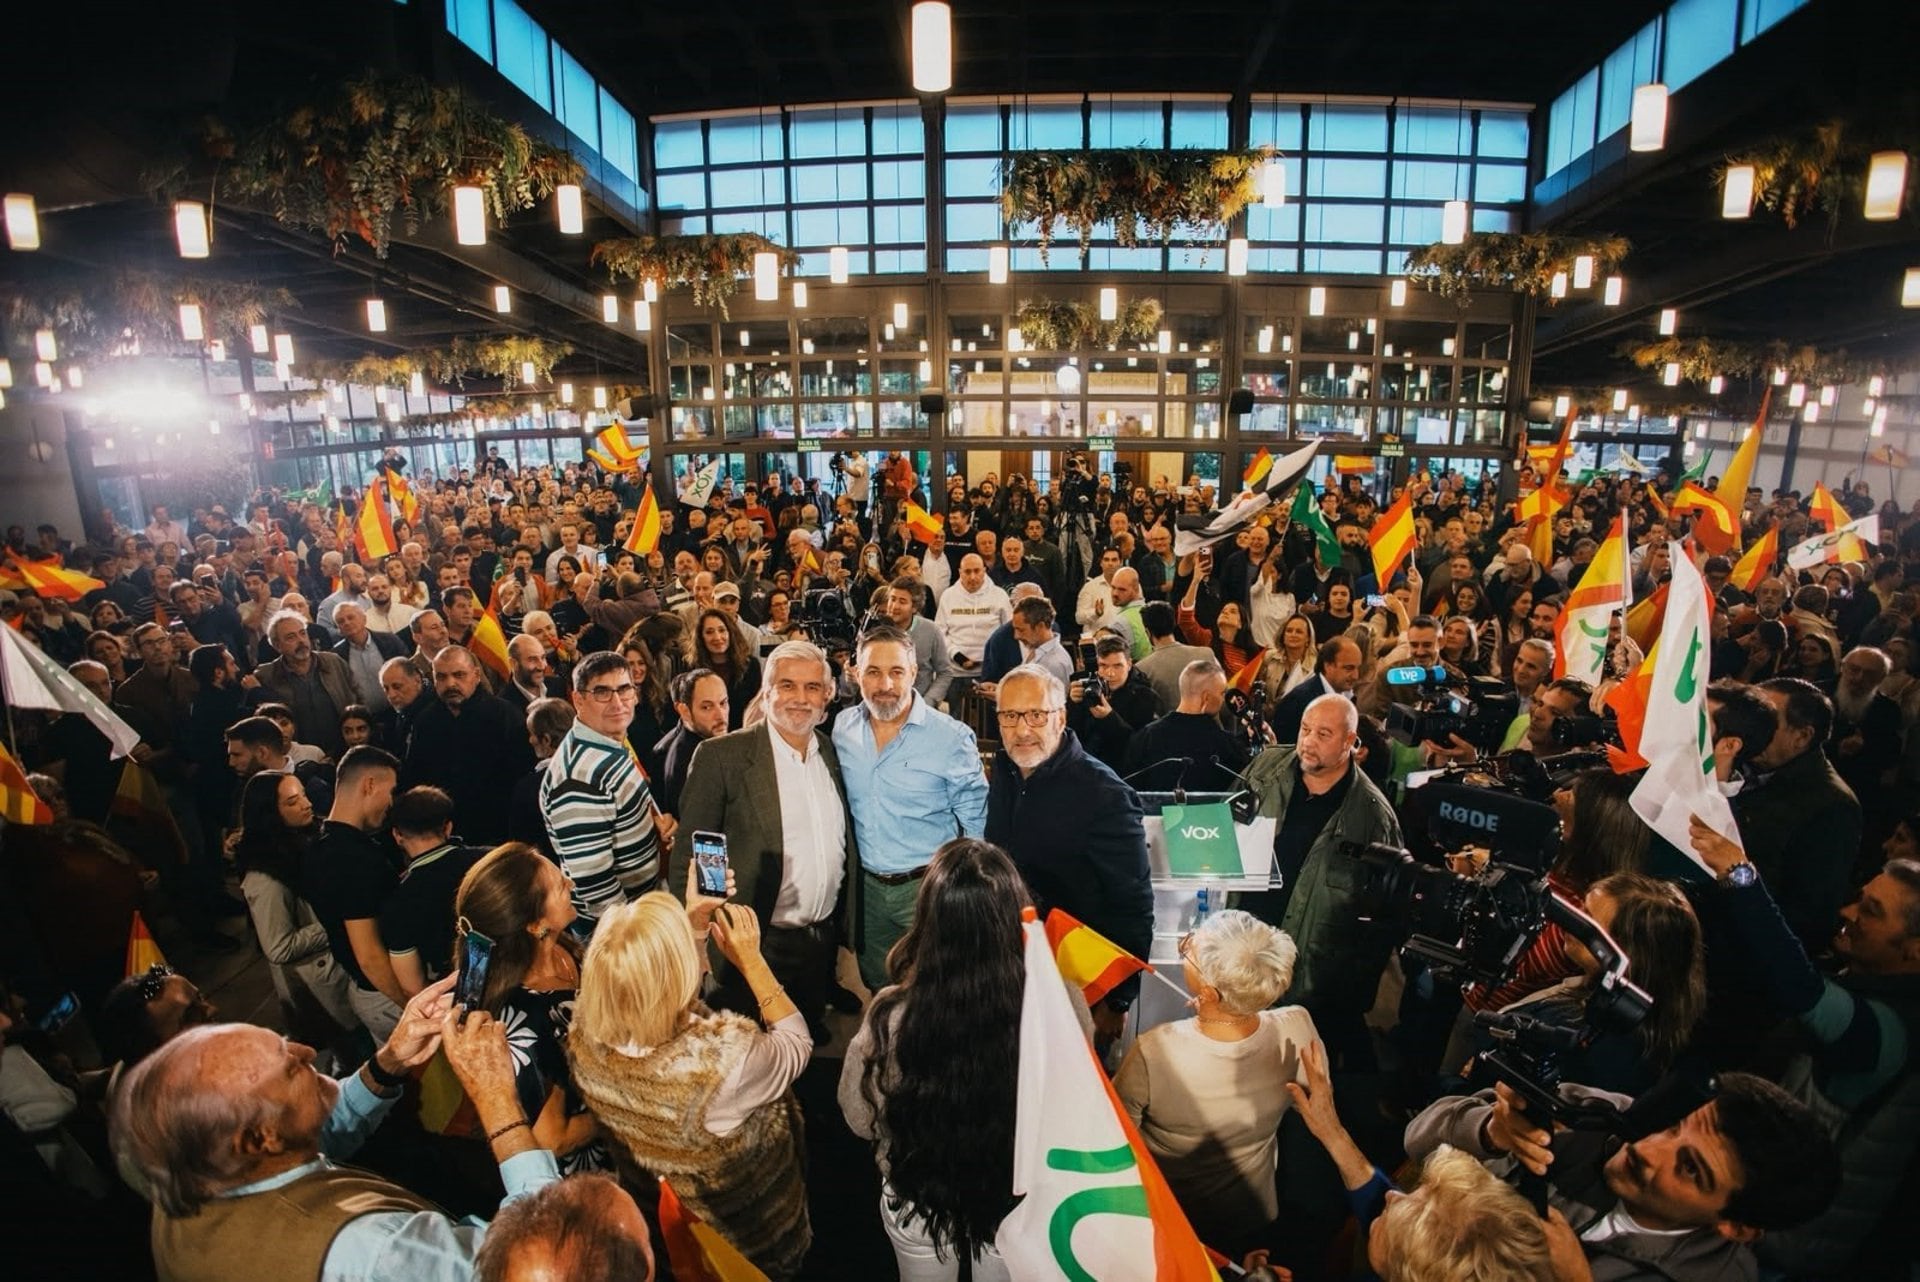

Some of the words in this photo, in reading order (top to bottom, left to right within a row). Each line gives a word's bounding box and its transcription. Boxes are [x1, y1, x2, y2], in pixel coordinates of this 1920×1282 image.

[1400, 670, 1418, 681] tve
[1440, 801, 1498, 832] RØDE
[1181, 825, 1220, 840] VOX
